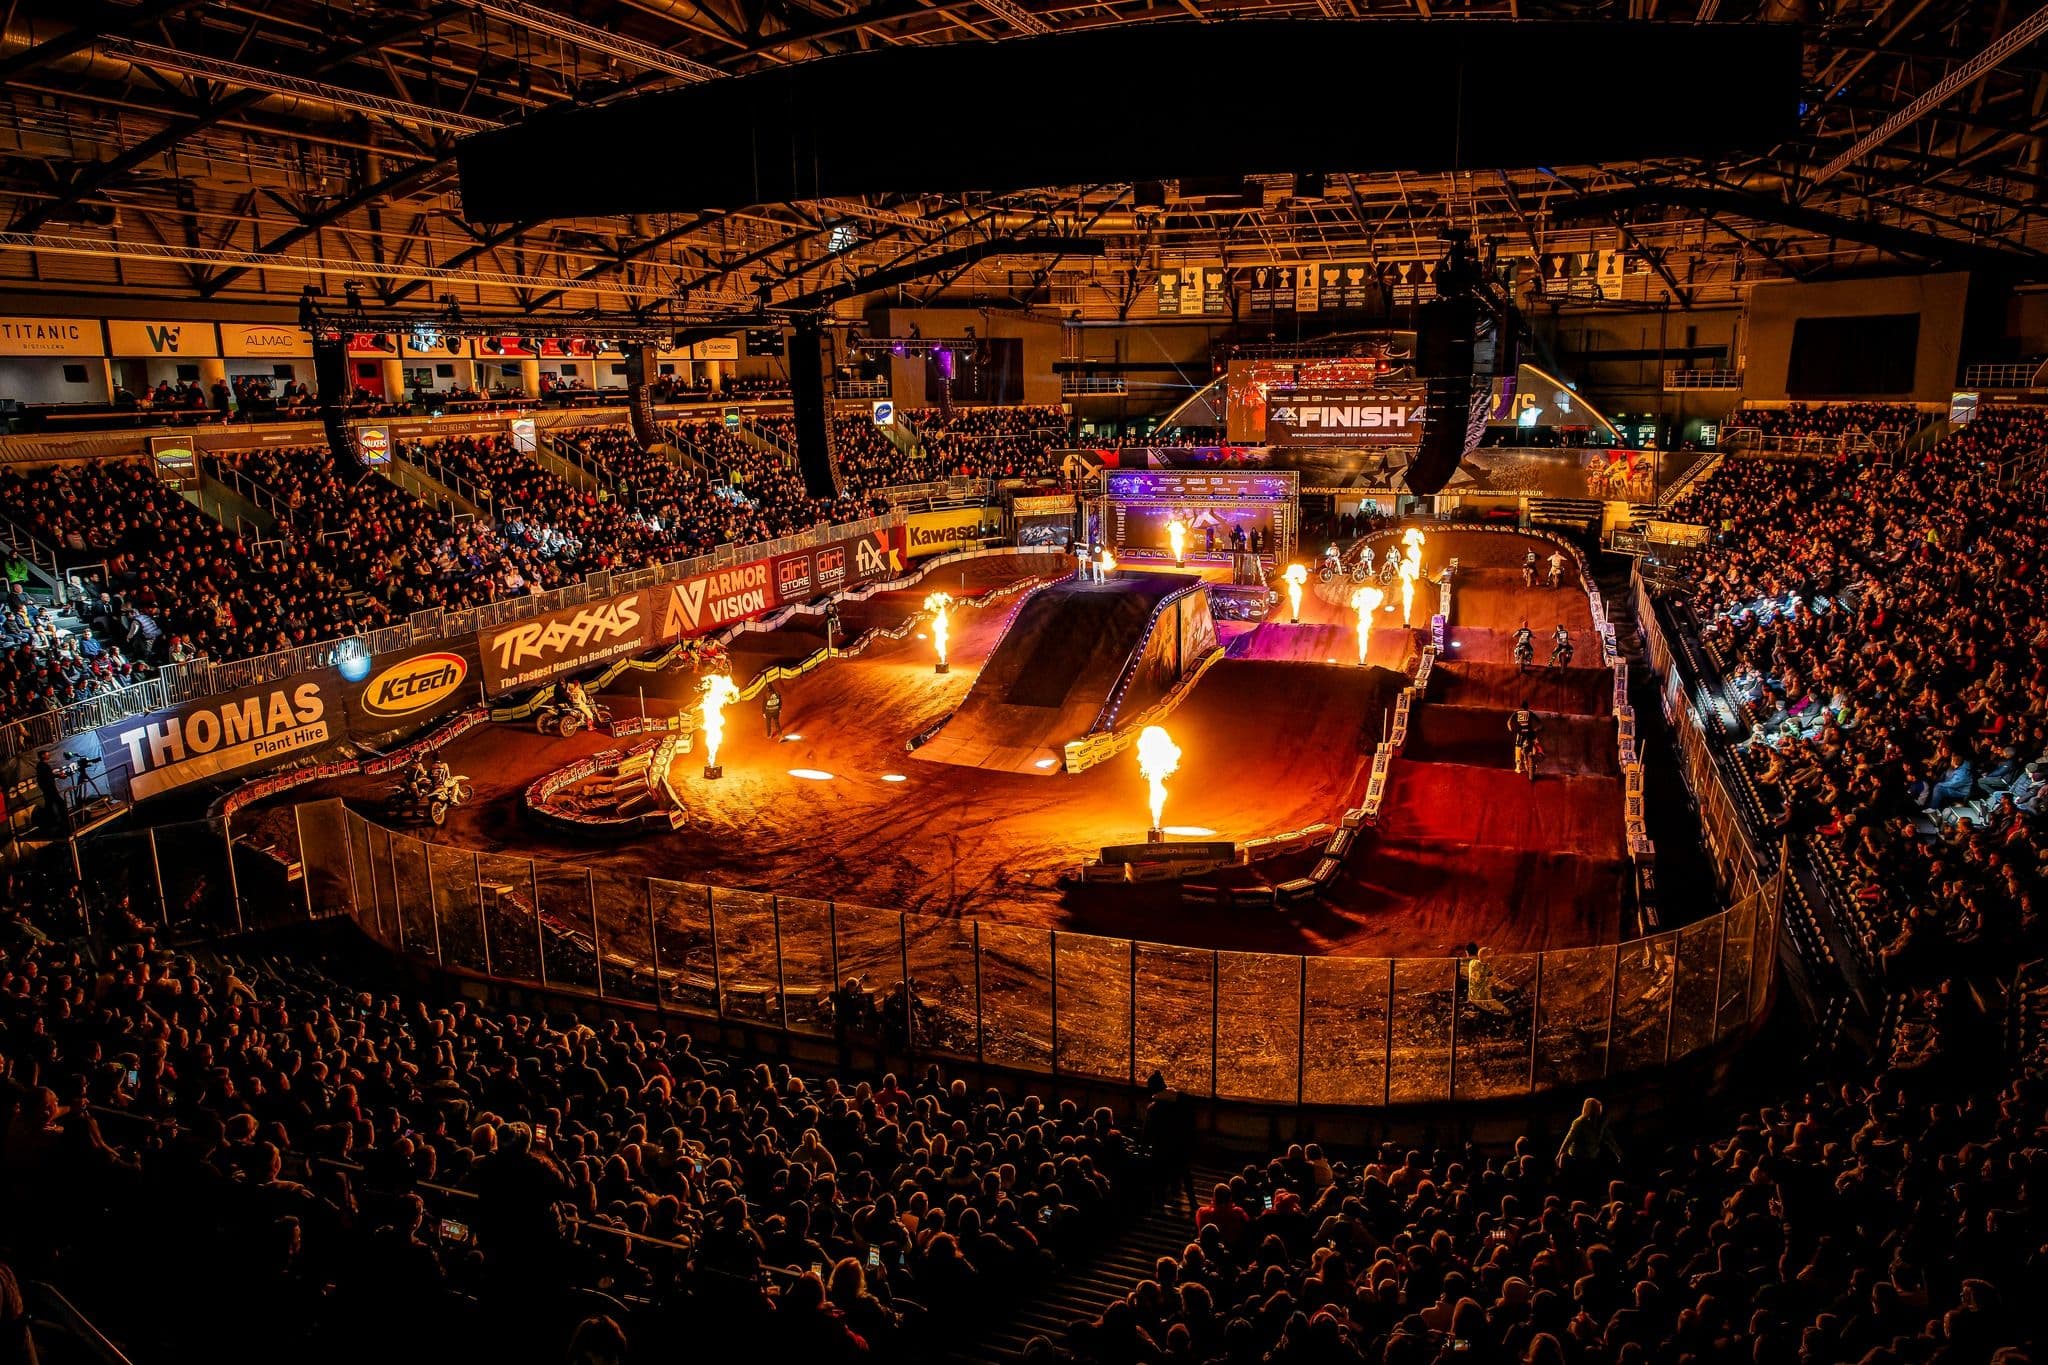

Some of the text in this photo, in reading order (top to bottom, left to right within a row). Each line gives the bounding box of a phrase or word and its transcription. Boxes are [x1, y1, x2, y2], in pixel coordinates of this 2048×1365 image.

[2, 324, 79, 340] TITANIC
[245, 335, 294, 347] ALMAC
[1299, 406, 1406, 428] FINISH
[362, 439, 388, 449] WALKERS
[909, 520, 983, 547] Kawasa
[780, 559, 808, 582] dirt
[818, 550, 843, 572] dirt
[708, 564, 767, 599] ARMOR
[781, 576, 810, 592] STORE
[819, 566, 844, 581] STORE
[859, 568, 880, 578] AUTO
[708, 588, 766, 624] VISION
[500, 637, 642, 689] The Fastest Name In Radio Control
[120, 682, 324, 775] THOMAS
[616, 722, 641, 733] dirt
[254, 728, 324, 757] Plant Hire
